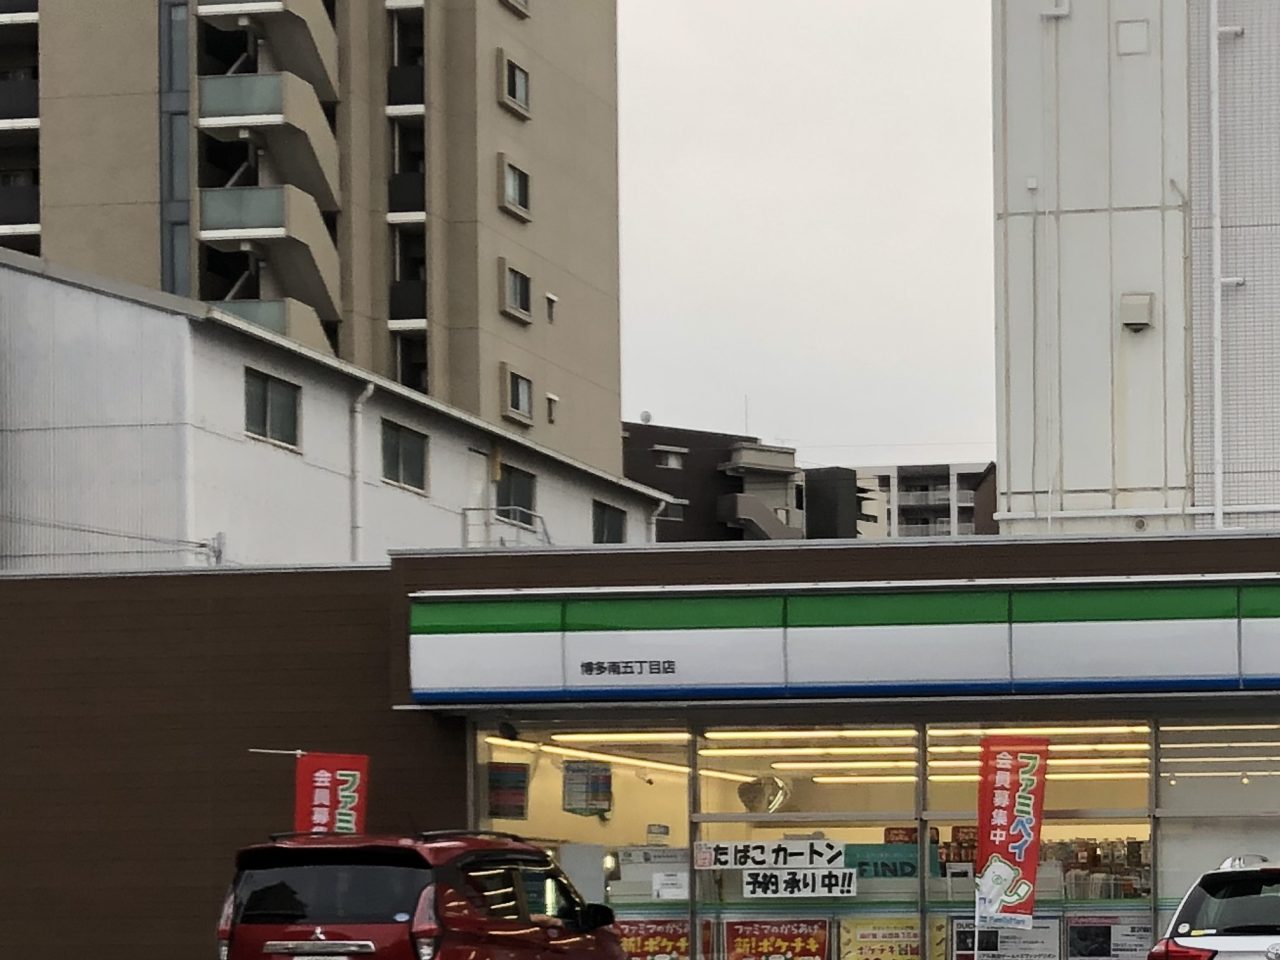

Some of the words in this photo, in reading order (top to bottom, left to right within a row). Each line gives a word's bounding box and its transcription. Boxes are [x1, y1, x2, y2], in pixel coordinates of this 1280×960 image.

[580, 660, 676, 675] 博多南五丁目店
[990, 752, 1013, 845] 会員募集中
[1009, 753, 1040, 862] ファミペイ
[857, 861, 917, 877] FIND
